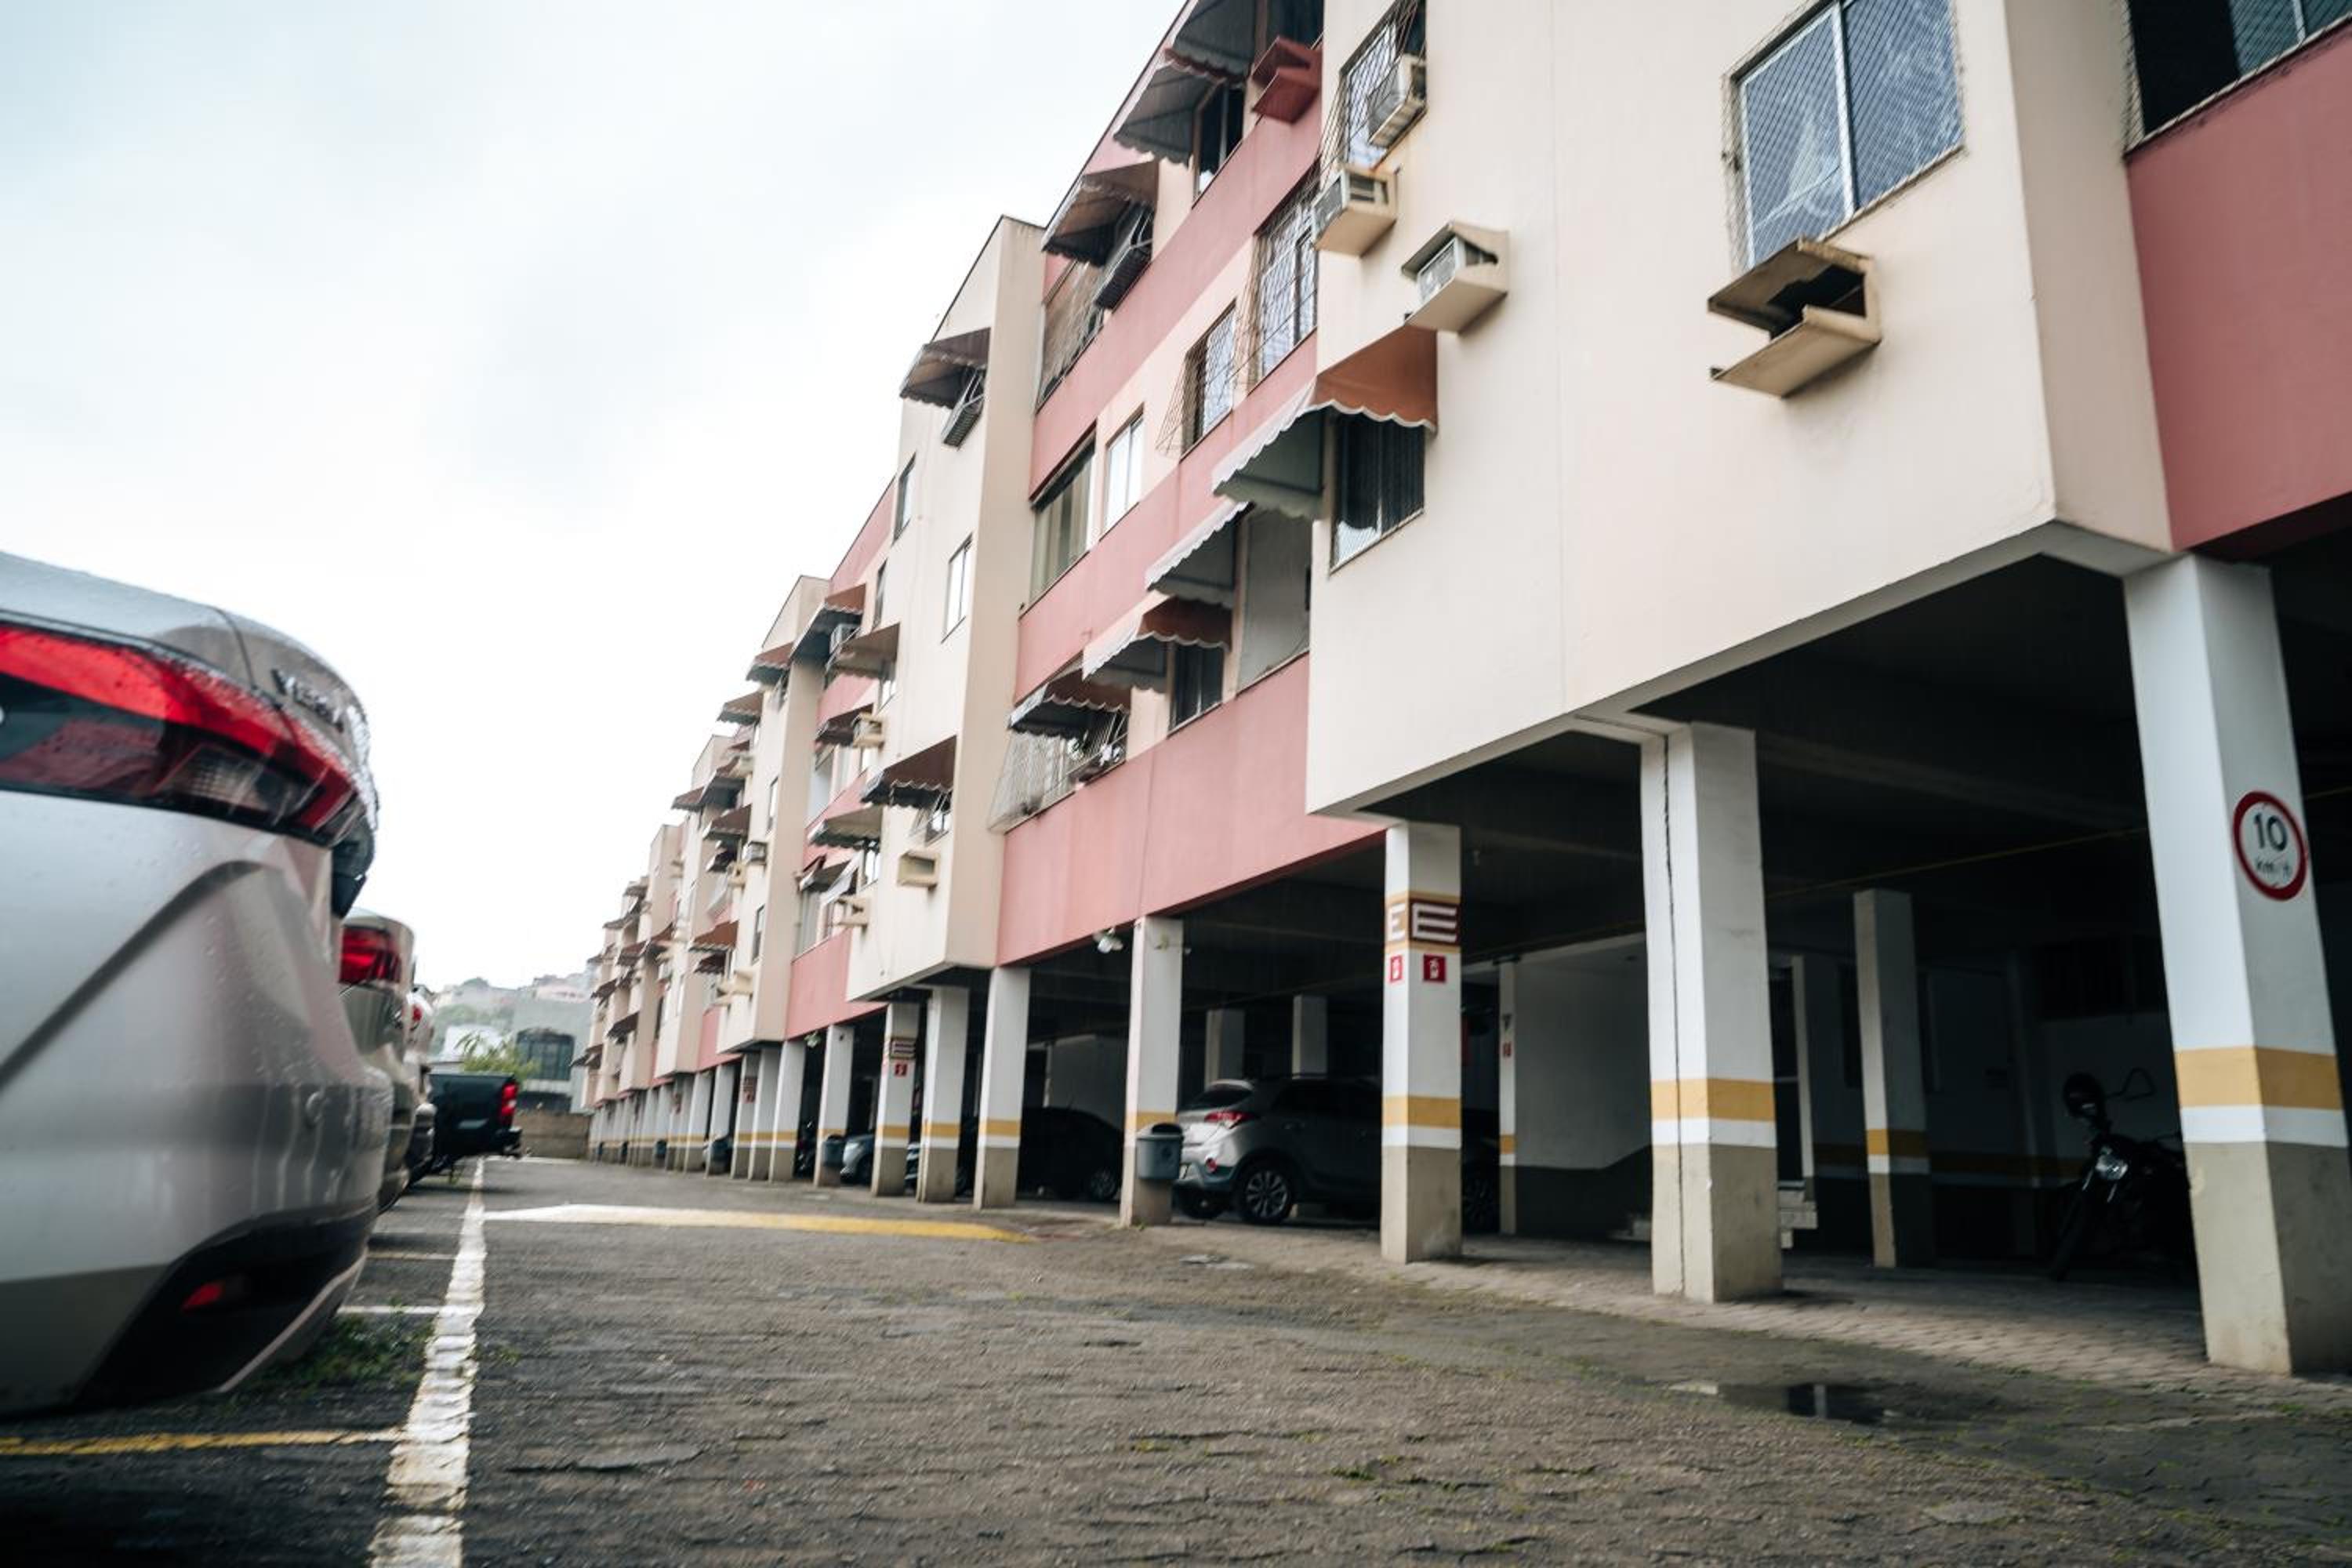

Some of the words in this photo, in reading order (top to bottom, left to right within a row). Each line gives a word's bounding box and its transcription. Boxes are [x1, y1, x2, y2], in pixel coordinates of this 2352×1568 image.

[2254, 812, 2288, 851] 10
[2254, 856, 2292, 881] kmh
[1387, 902, 1406, 942] E
[1412, 902, 1457, 943] E
